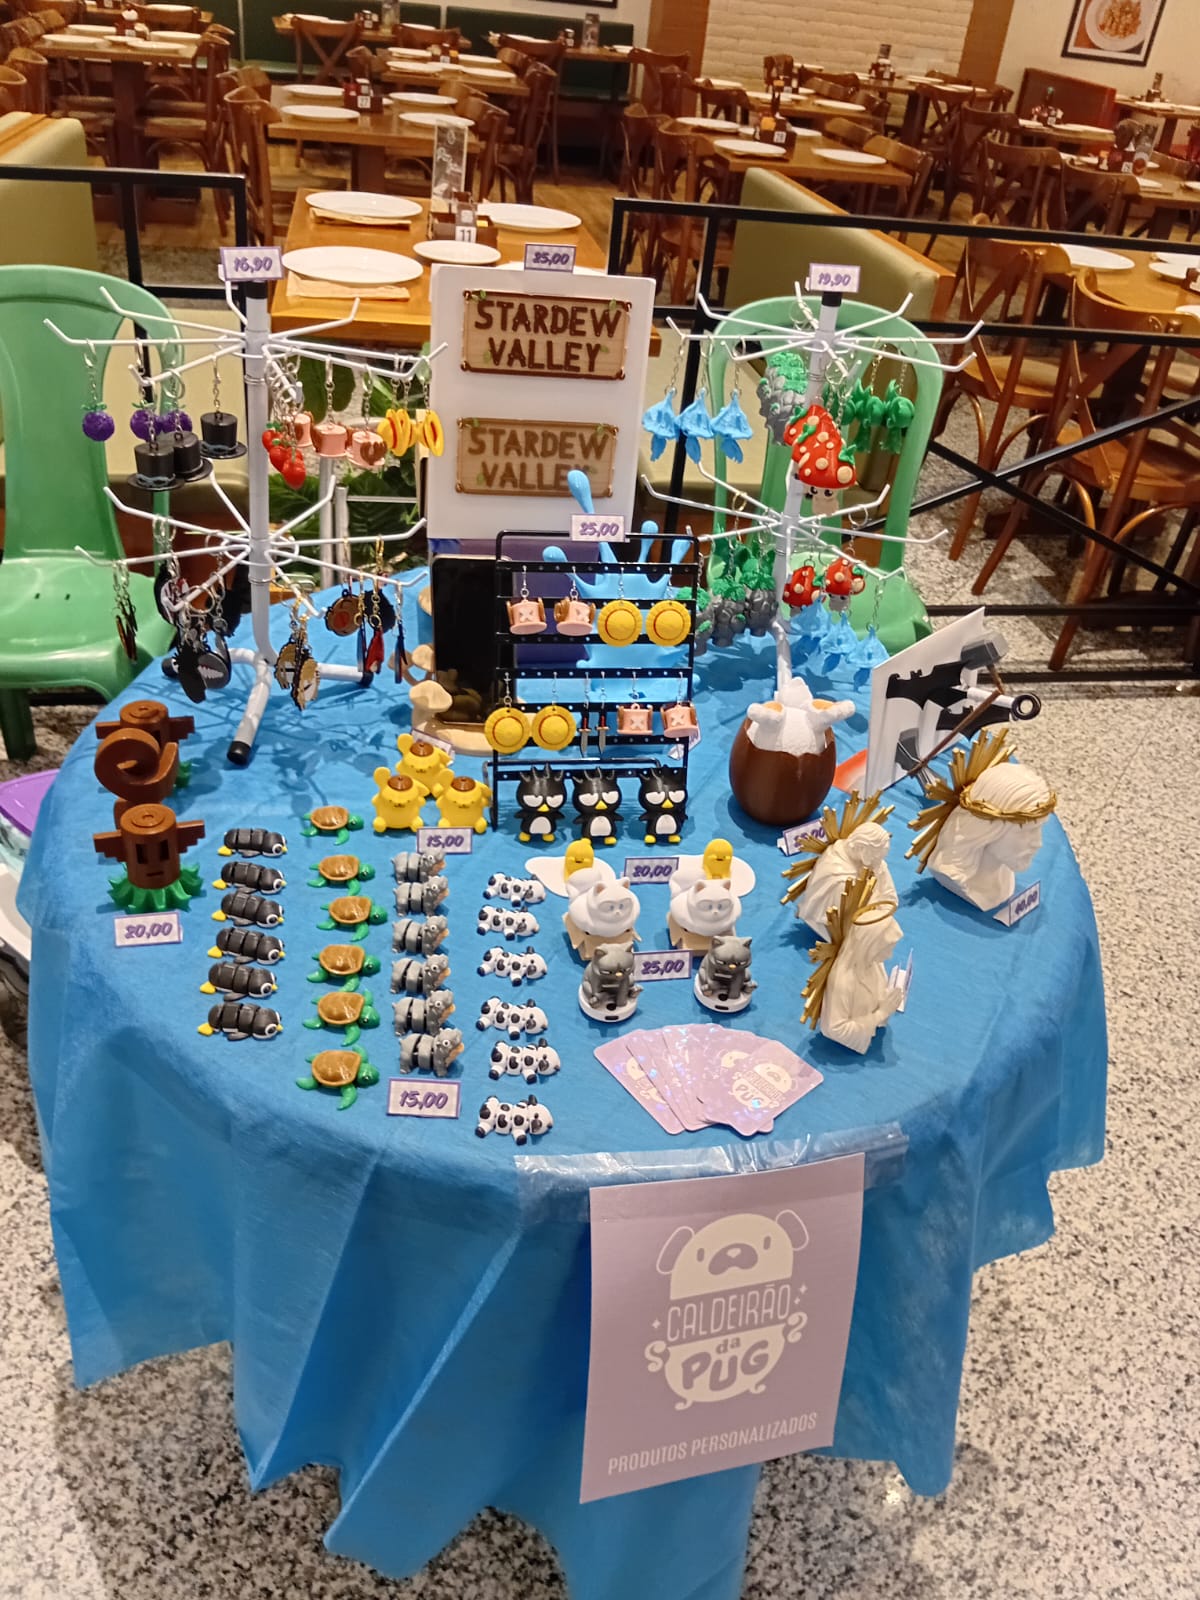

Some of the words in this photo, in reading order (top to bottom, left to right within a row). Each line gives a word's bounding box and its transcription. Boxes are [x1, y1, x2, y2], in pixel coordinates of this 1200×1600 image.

[234, 256, 273, 273] 16,90
[532, 251, 570, 266] 25,00
[818, 272, 852, 287] 19,90
[474, 300, 622, 338] STARDEW
[488, 337, 602, 373] VALLEY
[467, 427, 610, 460] STARDEW
[579, 522, 620, 538] 25,00
[426, 834, 465, 849] 15,00
[632, 864, 673, 878] 20,00
[124, 922, 173, 939] 20,00
[641, 959, 685, 976] 25,00
[399, 1089, 449, 1111] 15,00
[667, 1283, 791, 1342] CALDEIRÃO
[716, 1337, 741, 1354] da
[681, 1339, 769, 1392] PUG
[690, 1411, 818, 1457] PERSONALIZADOS
[607, 1441, 687, 1475] PRODUTOS
